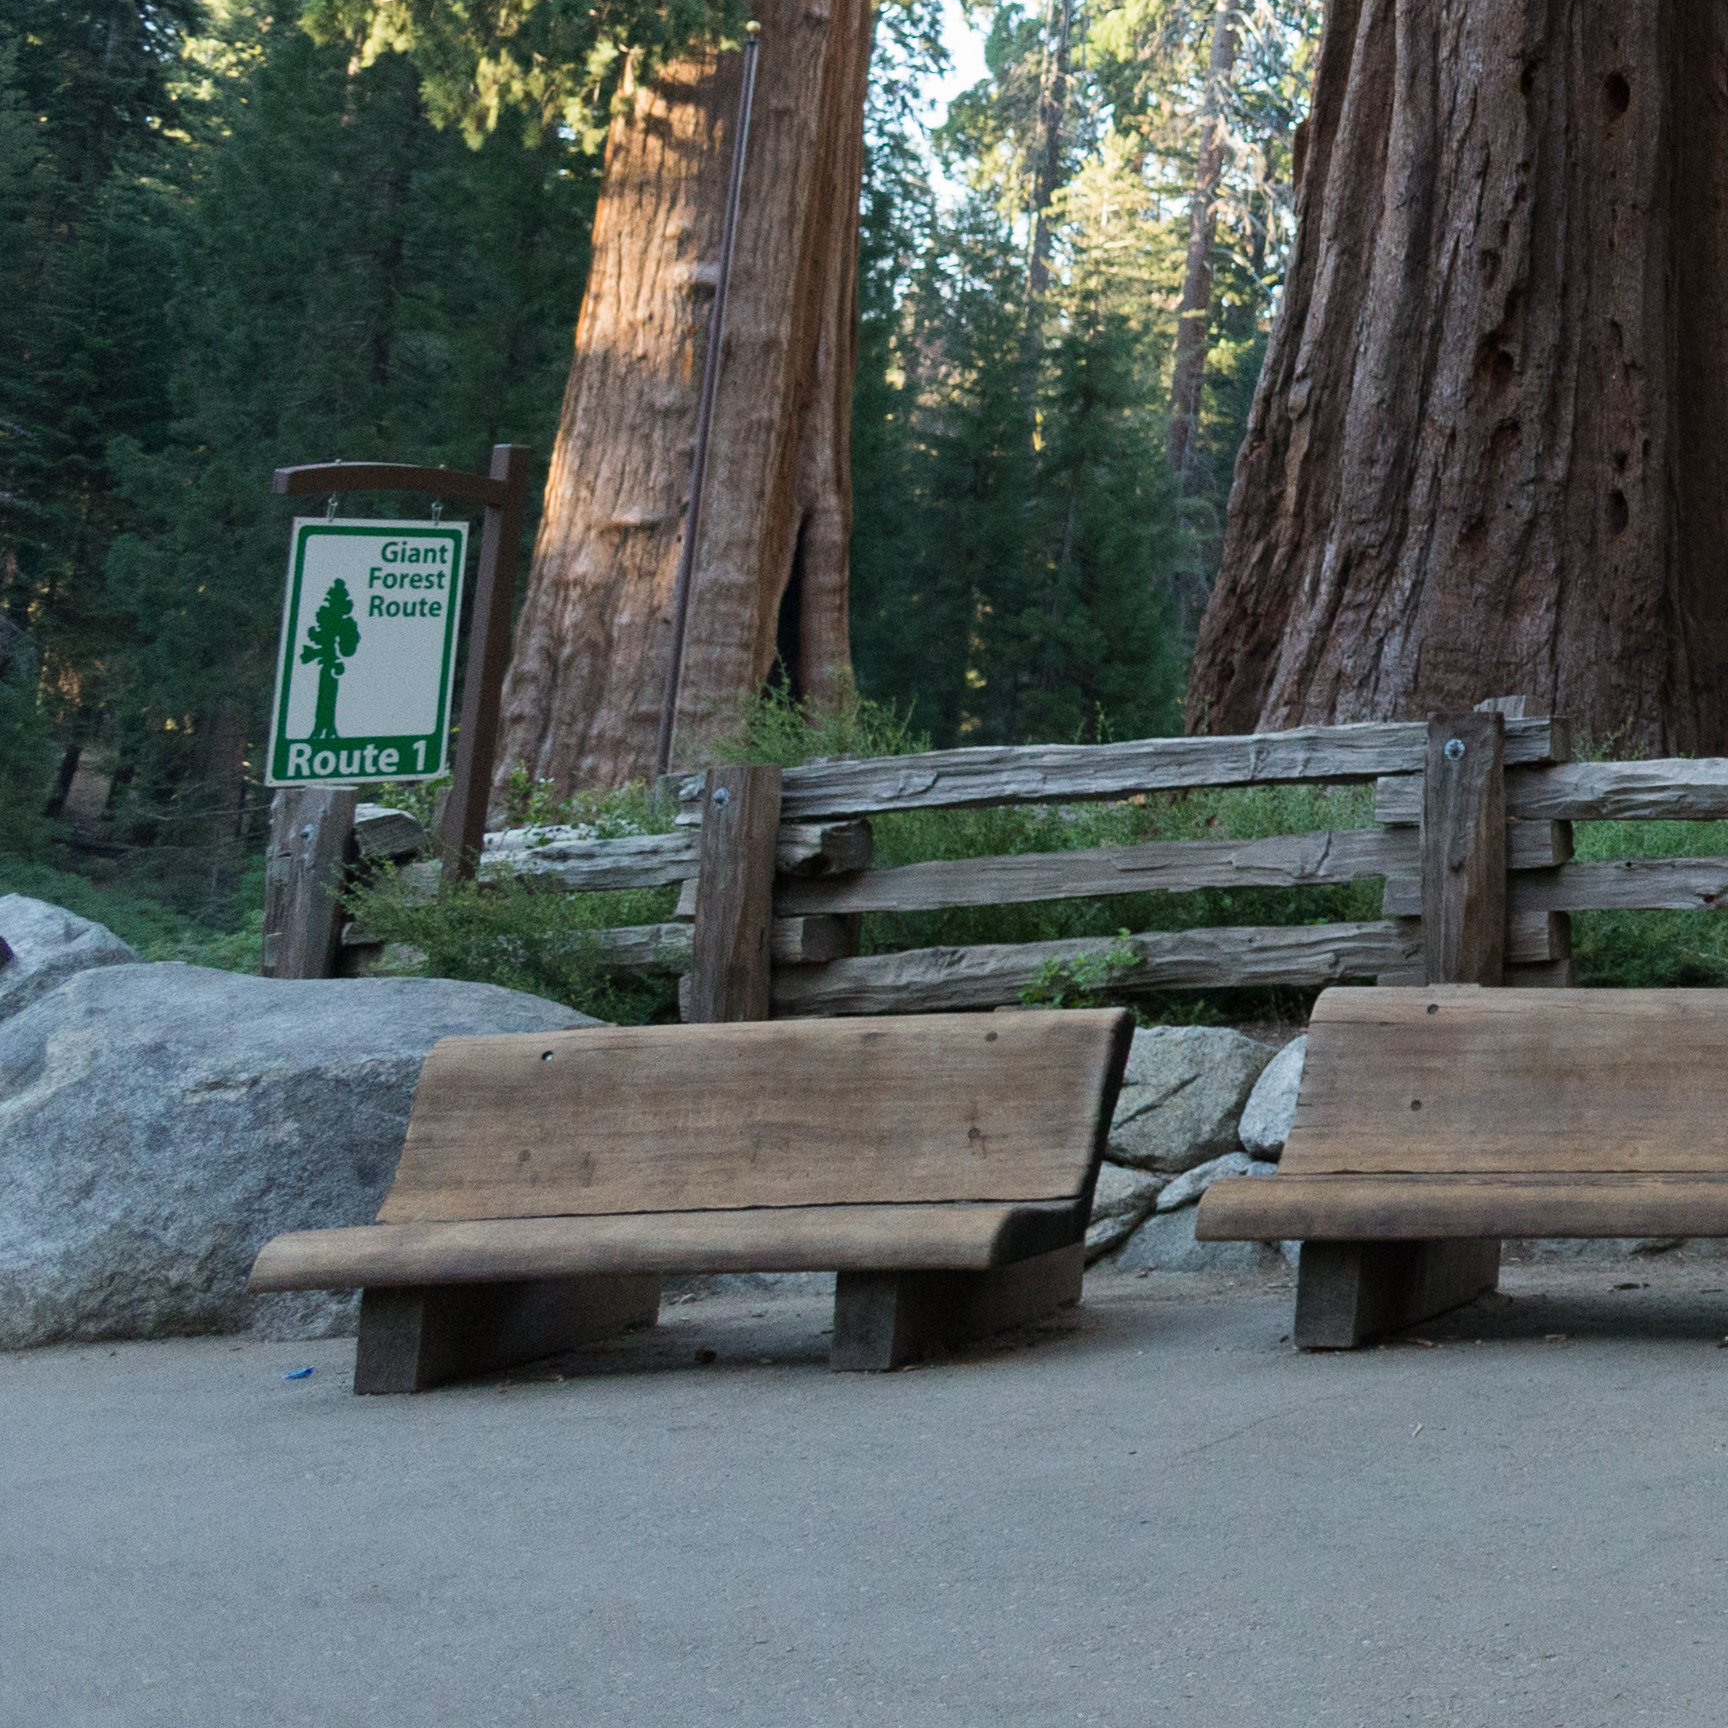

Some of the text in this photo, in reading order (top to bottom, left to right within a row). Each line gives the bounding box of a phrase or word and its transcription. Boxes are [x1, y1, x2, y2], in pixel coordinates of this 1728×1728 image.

[381, 541, 448, 564] Giant
[368, 567, 446, 589] Forest
[368, 595, 442, 617] Route
[286, 740, 427, 777] Route 1
